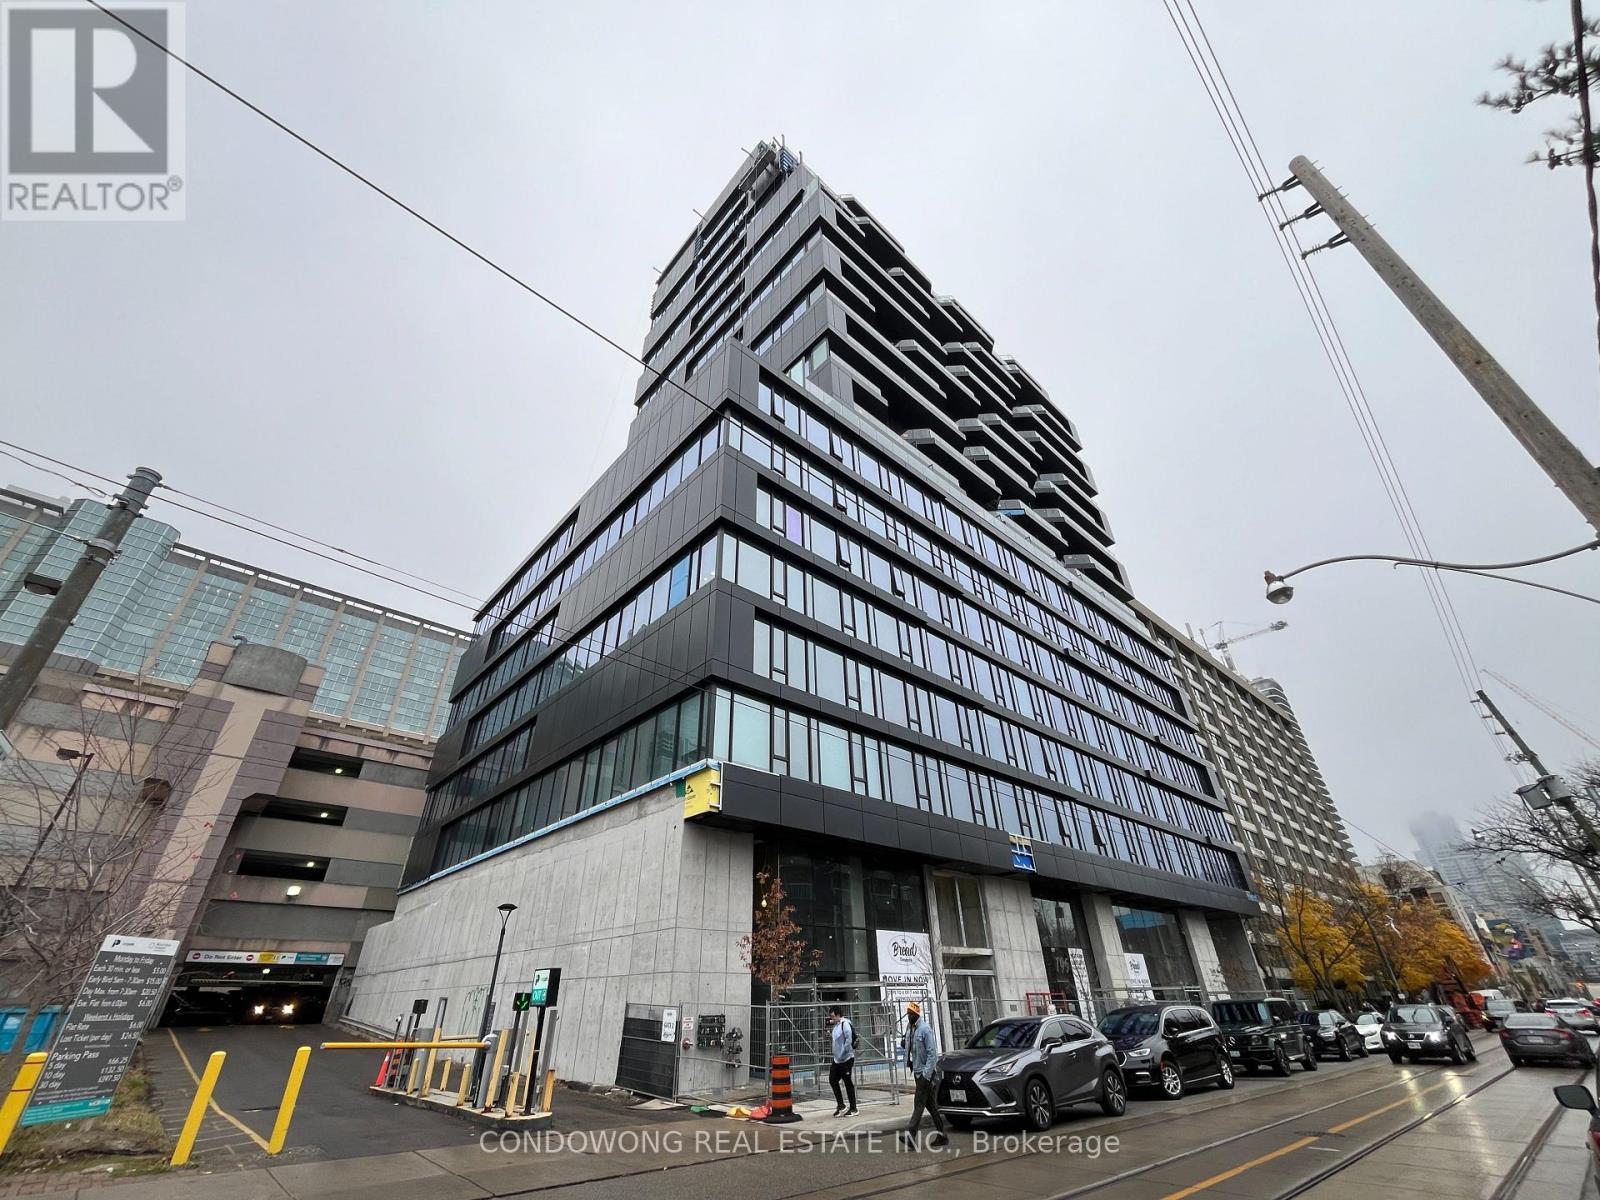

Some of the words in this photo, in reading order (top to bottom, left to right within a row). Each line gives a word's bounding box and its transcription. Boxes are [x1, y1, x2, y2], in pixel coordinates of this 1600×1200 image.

[891, 941, 917, 957] Bread
[114, 955, 133, 964] Monday
[88, 976, 100, 984] Early
[83, 987, 93, 996] Day
[51, 1052, 81, 1062] Parking
[82, 1051, 99, 1059] Pass
[54, 1062, 67, 1071] day
[52, 1071, 65, 1081] day
[49, 1080, 62, 1090] day
